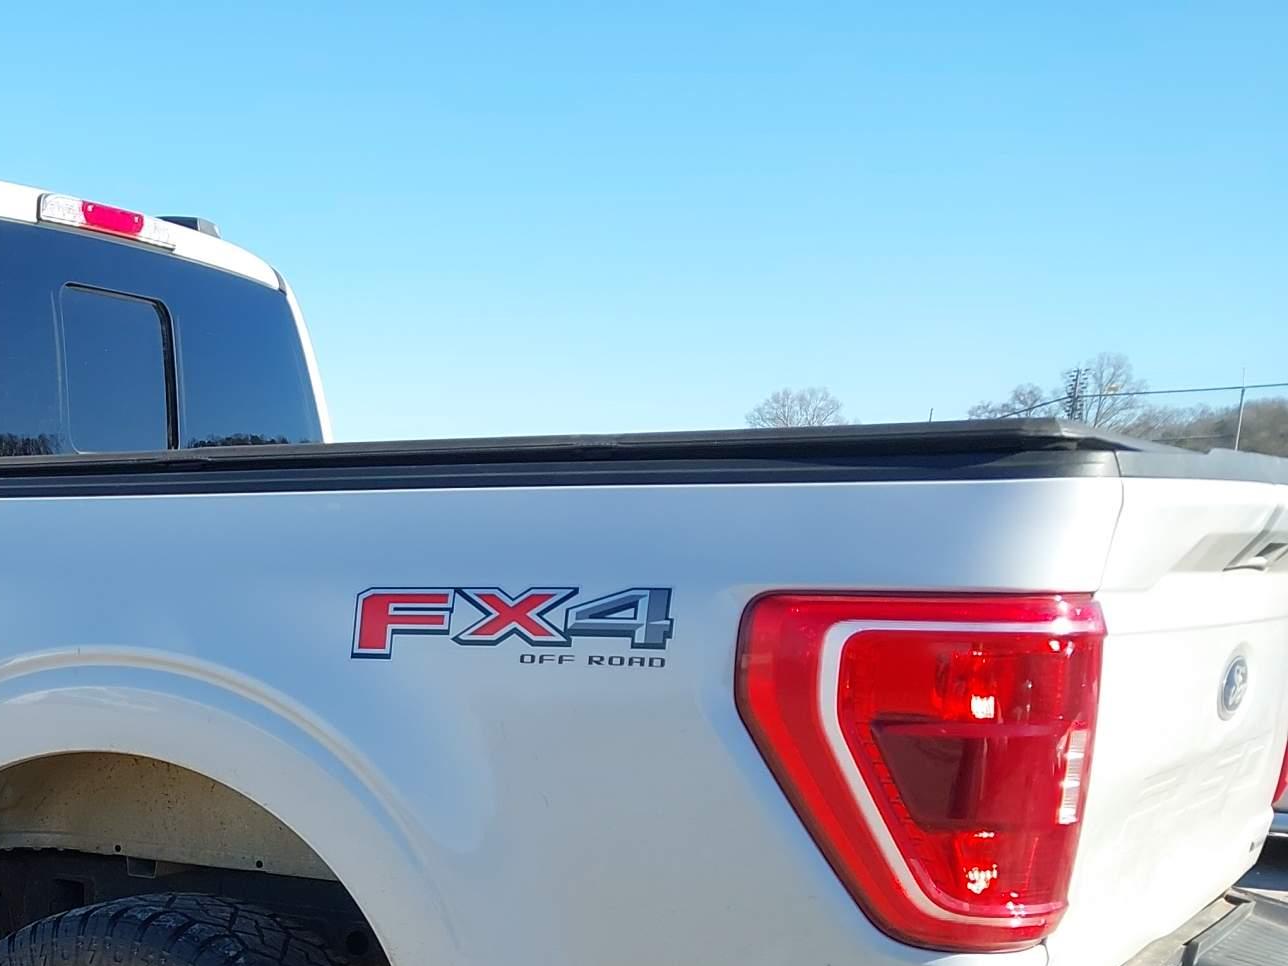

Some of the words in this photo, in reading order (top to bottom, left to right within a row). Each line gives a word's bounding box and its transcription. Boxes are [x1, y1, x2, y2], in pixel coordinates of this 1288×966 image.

[350, 586, 674, 660] FX4
[519, 653, 575, 665] OFF
[587, 655, 666, 668] ROAD
